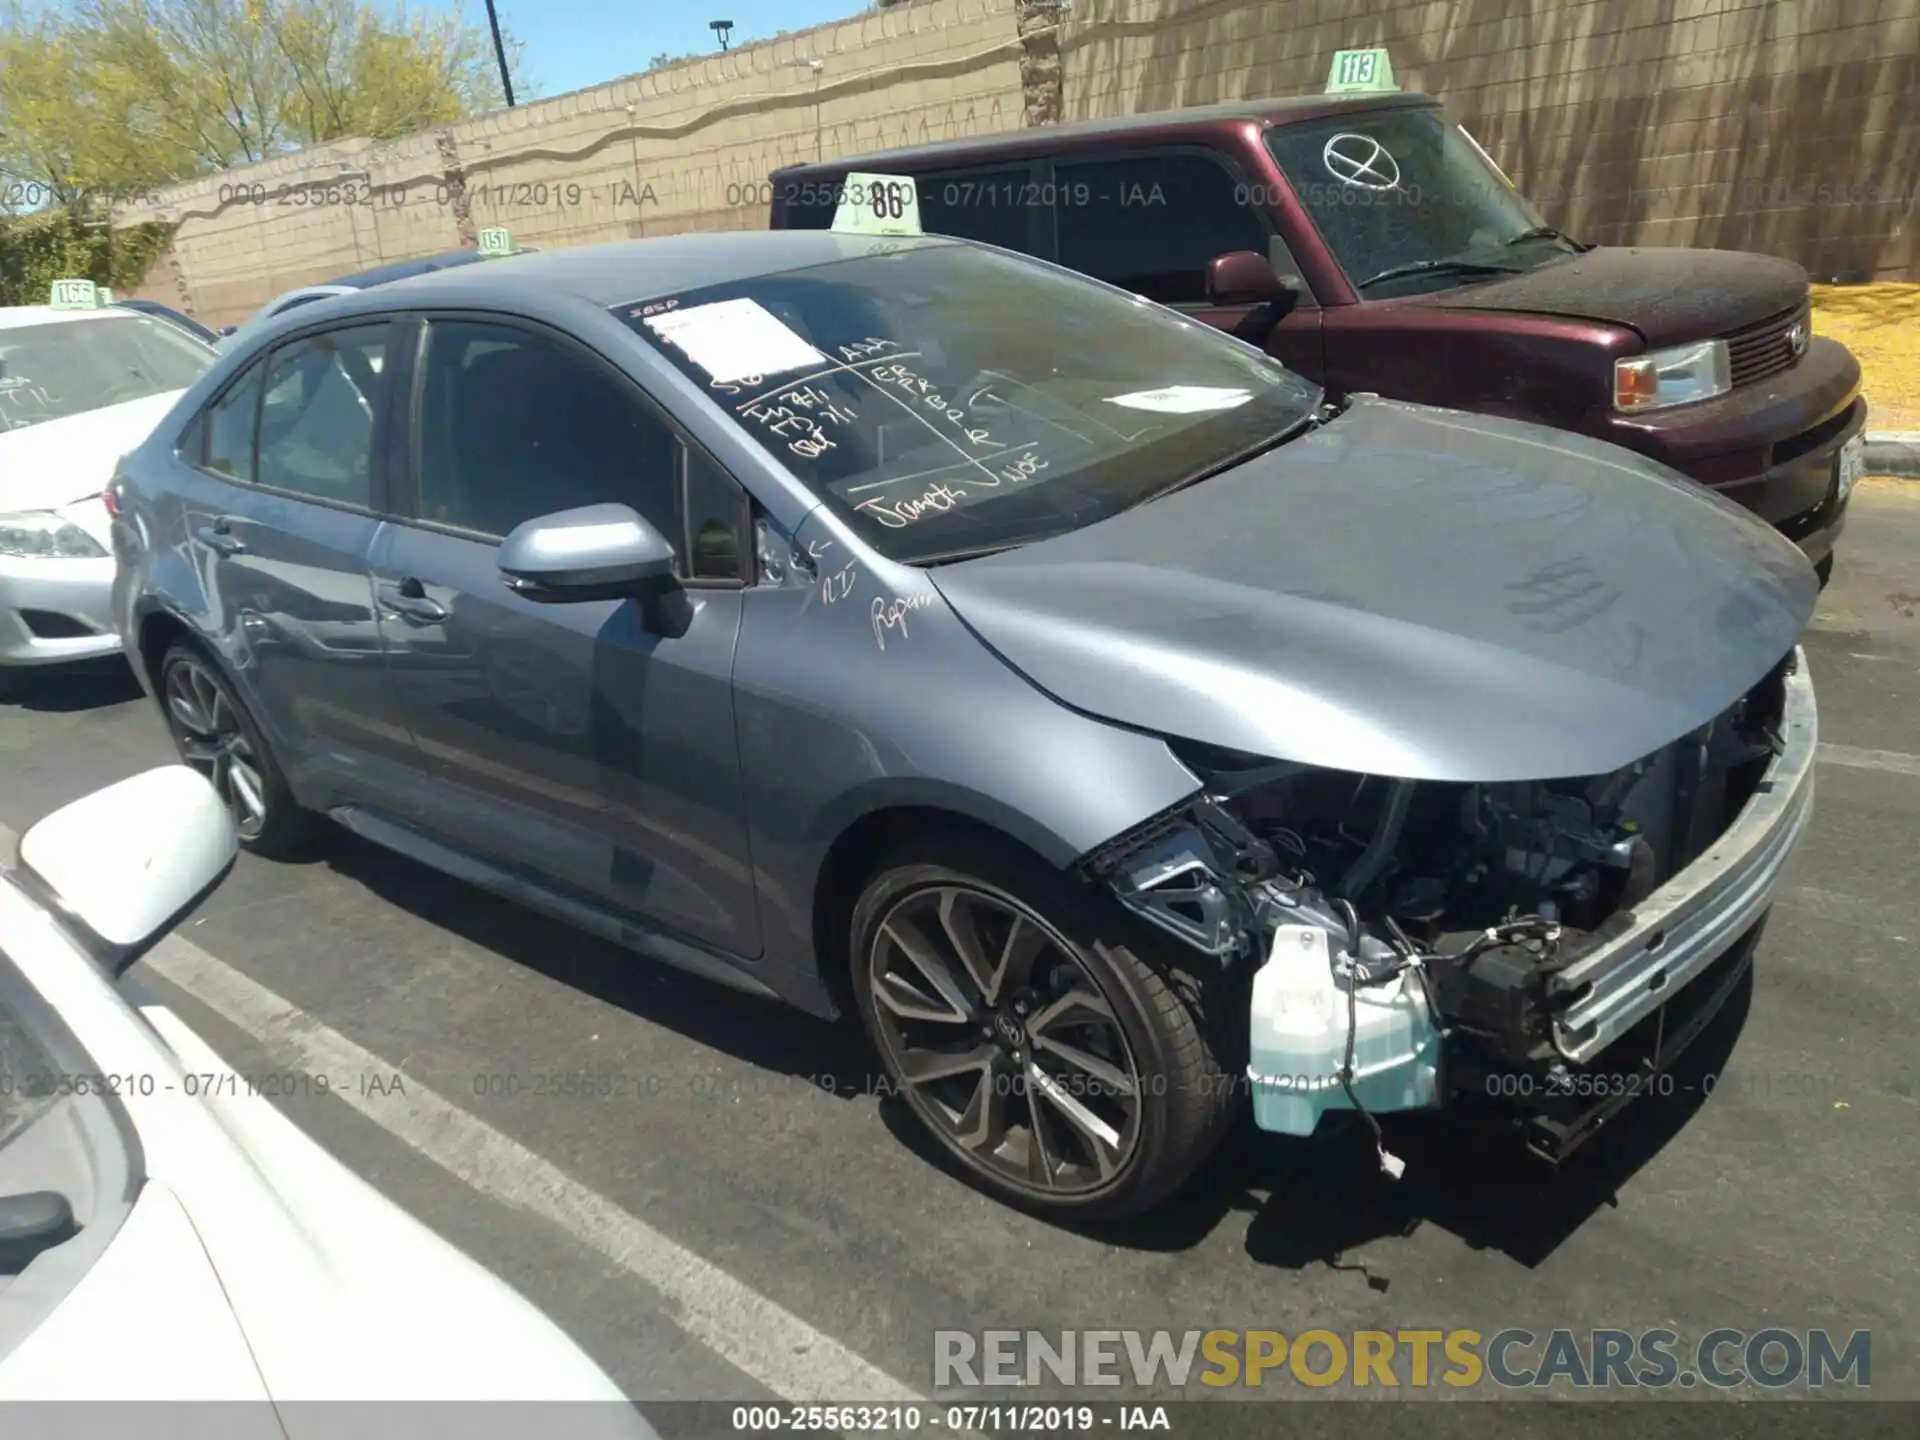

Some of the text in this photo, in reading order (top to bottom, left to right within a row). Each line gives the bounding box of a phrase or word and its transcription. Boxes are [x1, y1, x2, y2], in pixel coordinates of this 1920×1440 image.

[1342, 54, 1374, 83] 113
[871, 180, 903, 219] 86
[60, 283, 92, 303] 166
